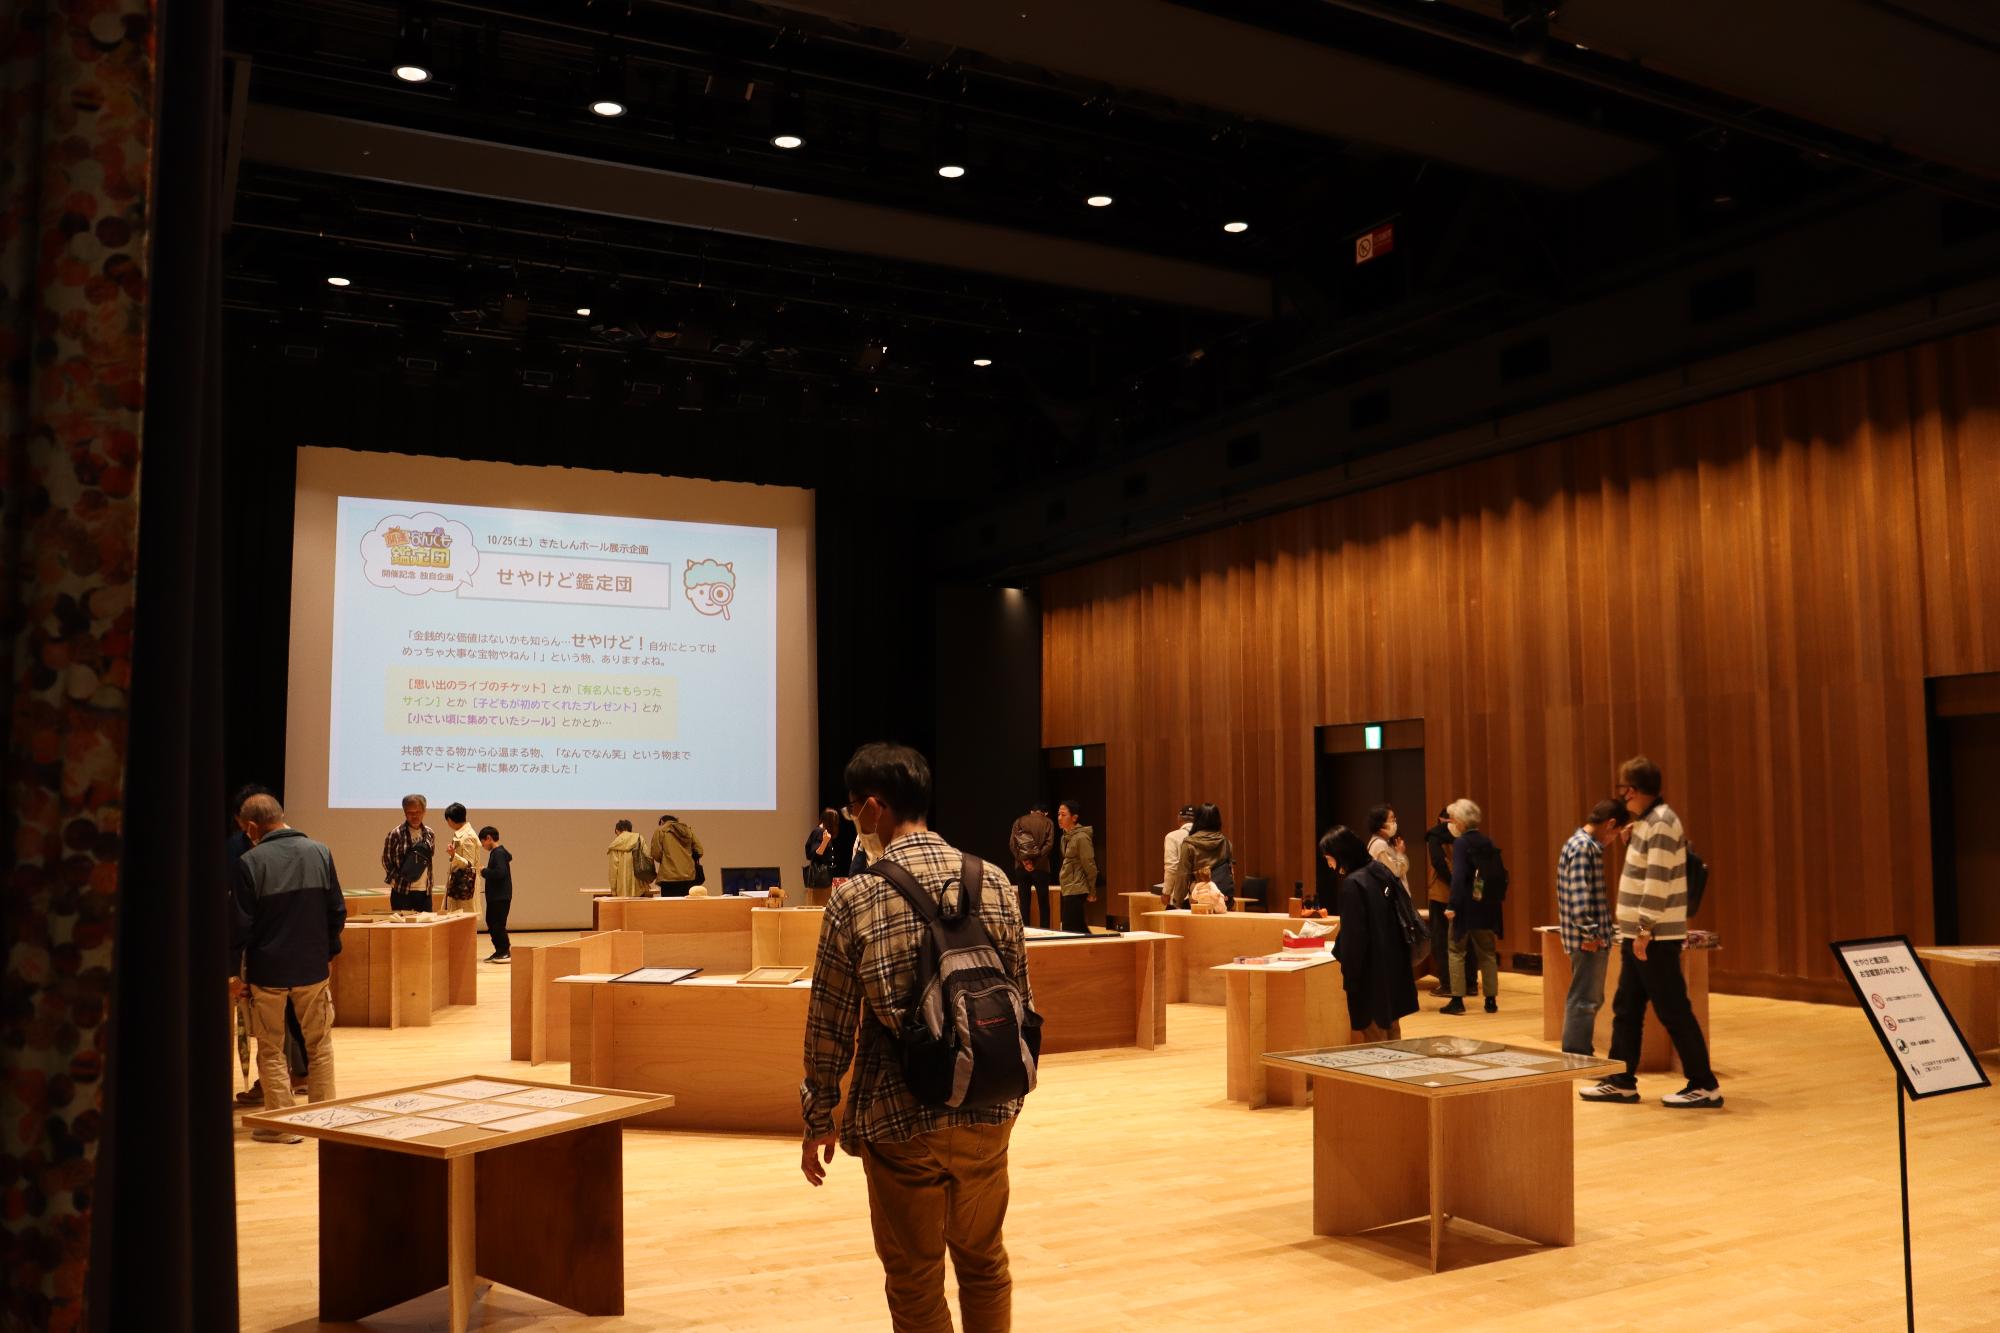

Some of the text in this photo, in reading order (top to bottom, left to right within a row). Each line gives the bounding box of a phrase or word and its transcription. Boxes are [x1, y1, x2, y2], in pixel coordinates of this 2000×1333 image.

[488, 535, 649, 555] 10/25(土) きたしんホール展示企画
[382, 570, 416, 580] 開催記念
[497, 568, 633, 593] せやけど鑑定団
